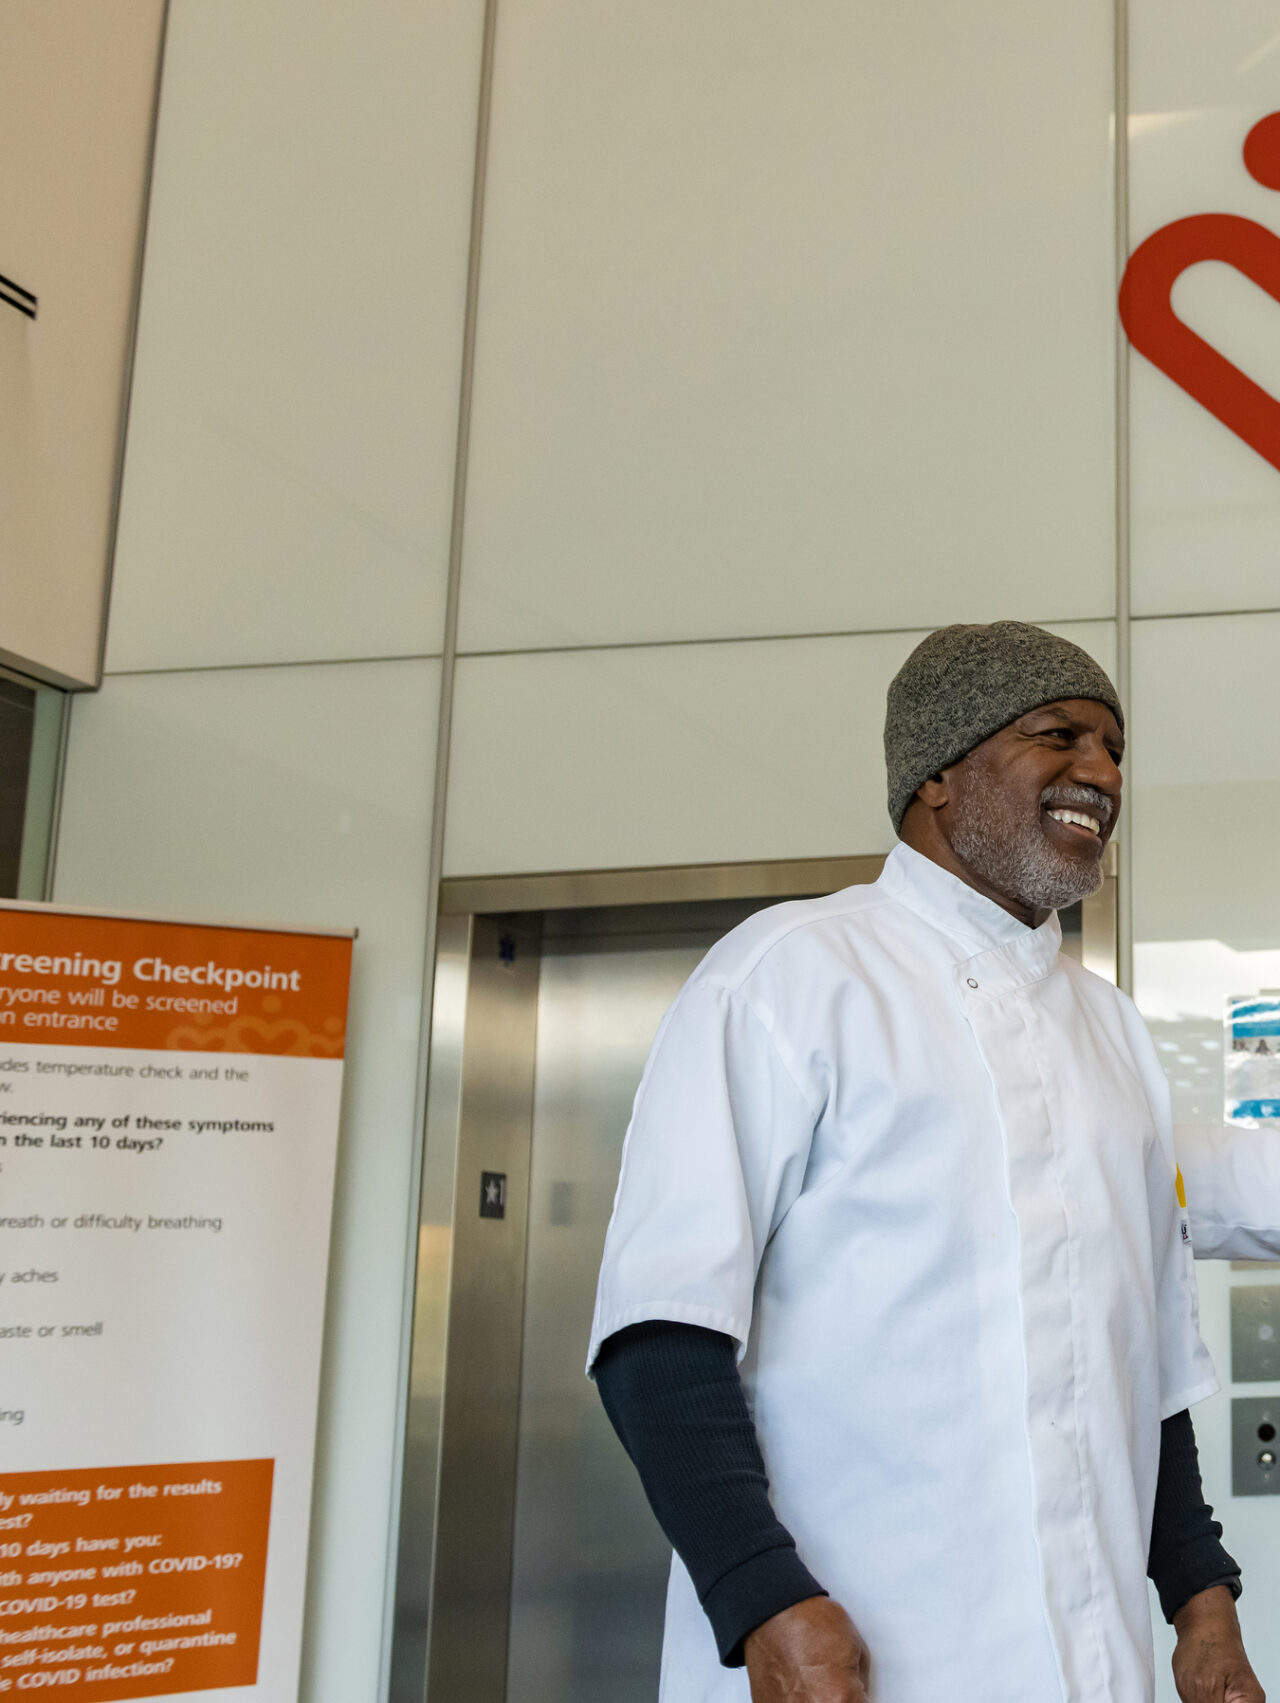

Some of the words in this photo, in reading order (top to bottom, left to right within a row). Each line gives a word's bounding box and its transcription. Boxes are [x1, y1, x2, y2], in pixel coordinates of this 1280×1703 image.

[0, 951, 122, 986] reening
[133, 957, 301, 993] Checkpoint
[68, 987, 105, 1007] will
[112, 989, 137, 1010] be
[145, 993, 238, 1015] screened
[24, 1010, 118, 1031] entrance
[36, 1060, 134, 1079] temperature
[139, 1063, 182, 1079] check
[189, 1066, 218, 1080] and
[225, 1067, 248, 1081] the
[74, 1115, 105, 1131] any
[112, 1114, 130, 1129] of
[136, 1115, 181, 1131] these
[188, 1118, 274, 1134] symptoms
[15, 1134, 43, 1149] the
[50, 1134, 82, 1149] last
[91, 1135, 109, 1149] 10
[116, 1136, 163, 1152] days?
[0, 1213, 44, 1228] reath
[51, 1216, 67, 1228] or
[74, 1214, 142, 1233] difficulty
[148, 1215, 222, 1233] breathing
[11, 1268, 58, 1284] aches
[38, 1324, 55, 1338] or
[62, 1322, 103, 1337] smell
[20, 1486, 90, 1507] waiting
[97, 1484, 123, 1500] for
[129, 1481, 157, 1498] the
[164, 1478, 222, 1496] results
[27, 1538, 69, 1559] days
[76, 1535, 119, 1552] have
[27, 1566, 95, 1587] anyone
[102, 1559, 143, 1578] with
[148, 1551, 243, 1574] COVID-19?
[0, 1593, 87, 1617] COVID-19
[92, 1588, 136, 1608] test?
[102, 1609, 211, 1638] professional
[1, 1642, 107, 1670] self-isolate,
[114, 1642, 135, 1657] or
[140, 1629, 236, 1657] quarantine
[17, 1667, 80, 1690] COVID
[85, 1657, 174, 1682] infection?
